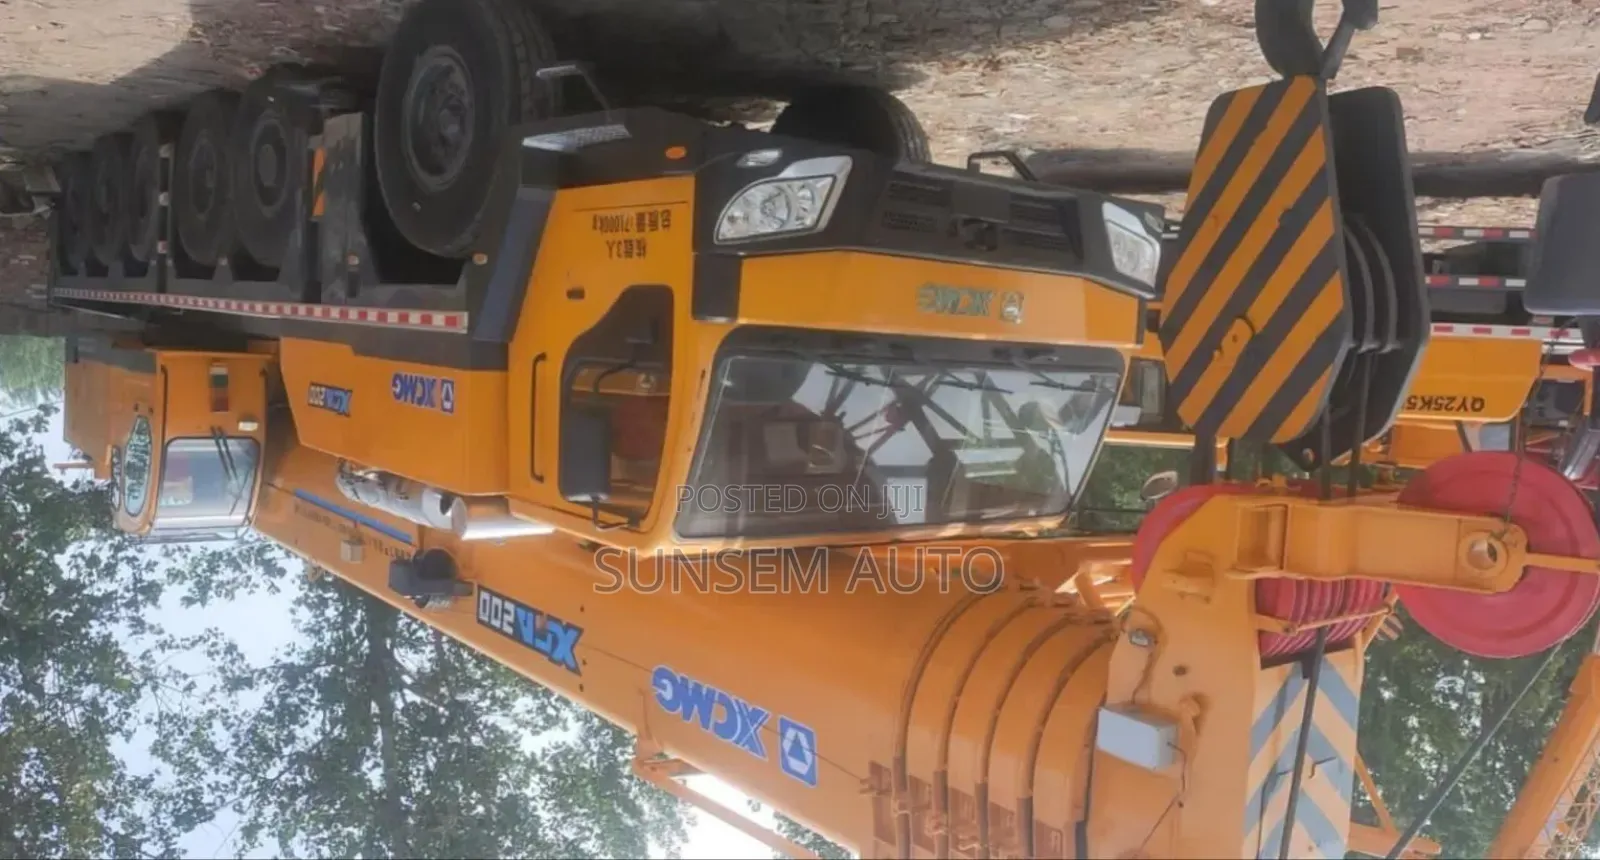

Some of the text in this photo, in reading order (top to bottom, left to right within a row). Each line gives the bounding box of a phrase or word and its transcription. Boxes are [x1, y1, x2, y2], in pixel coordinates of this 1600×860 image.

[916, 282, 997, 317] XCMG
[392, 373, 437, 409] XCMG
[1403, 395, 1485, 413] QY25K5
[652, 665, 770, 761] XCMG
